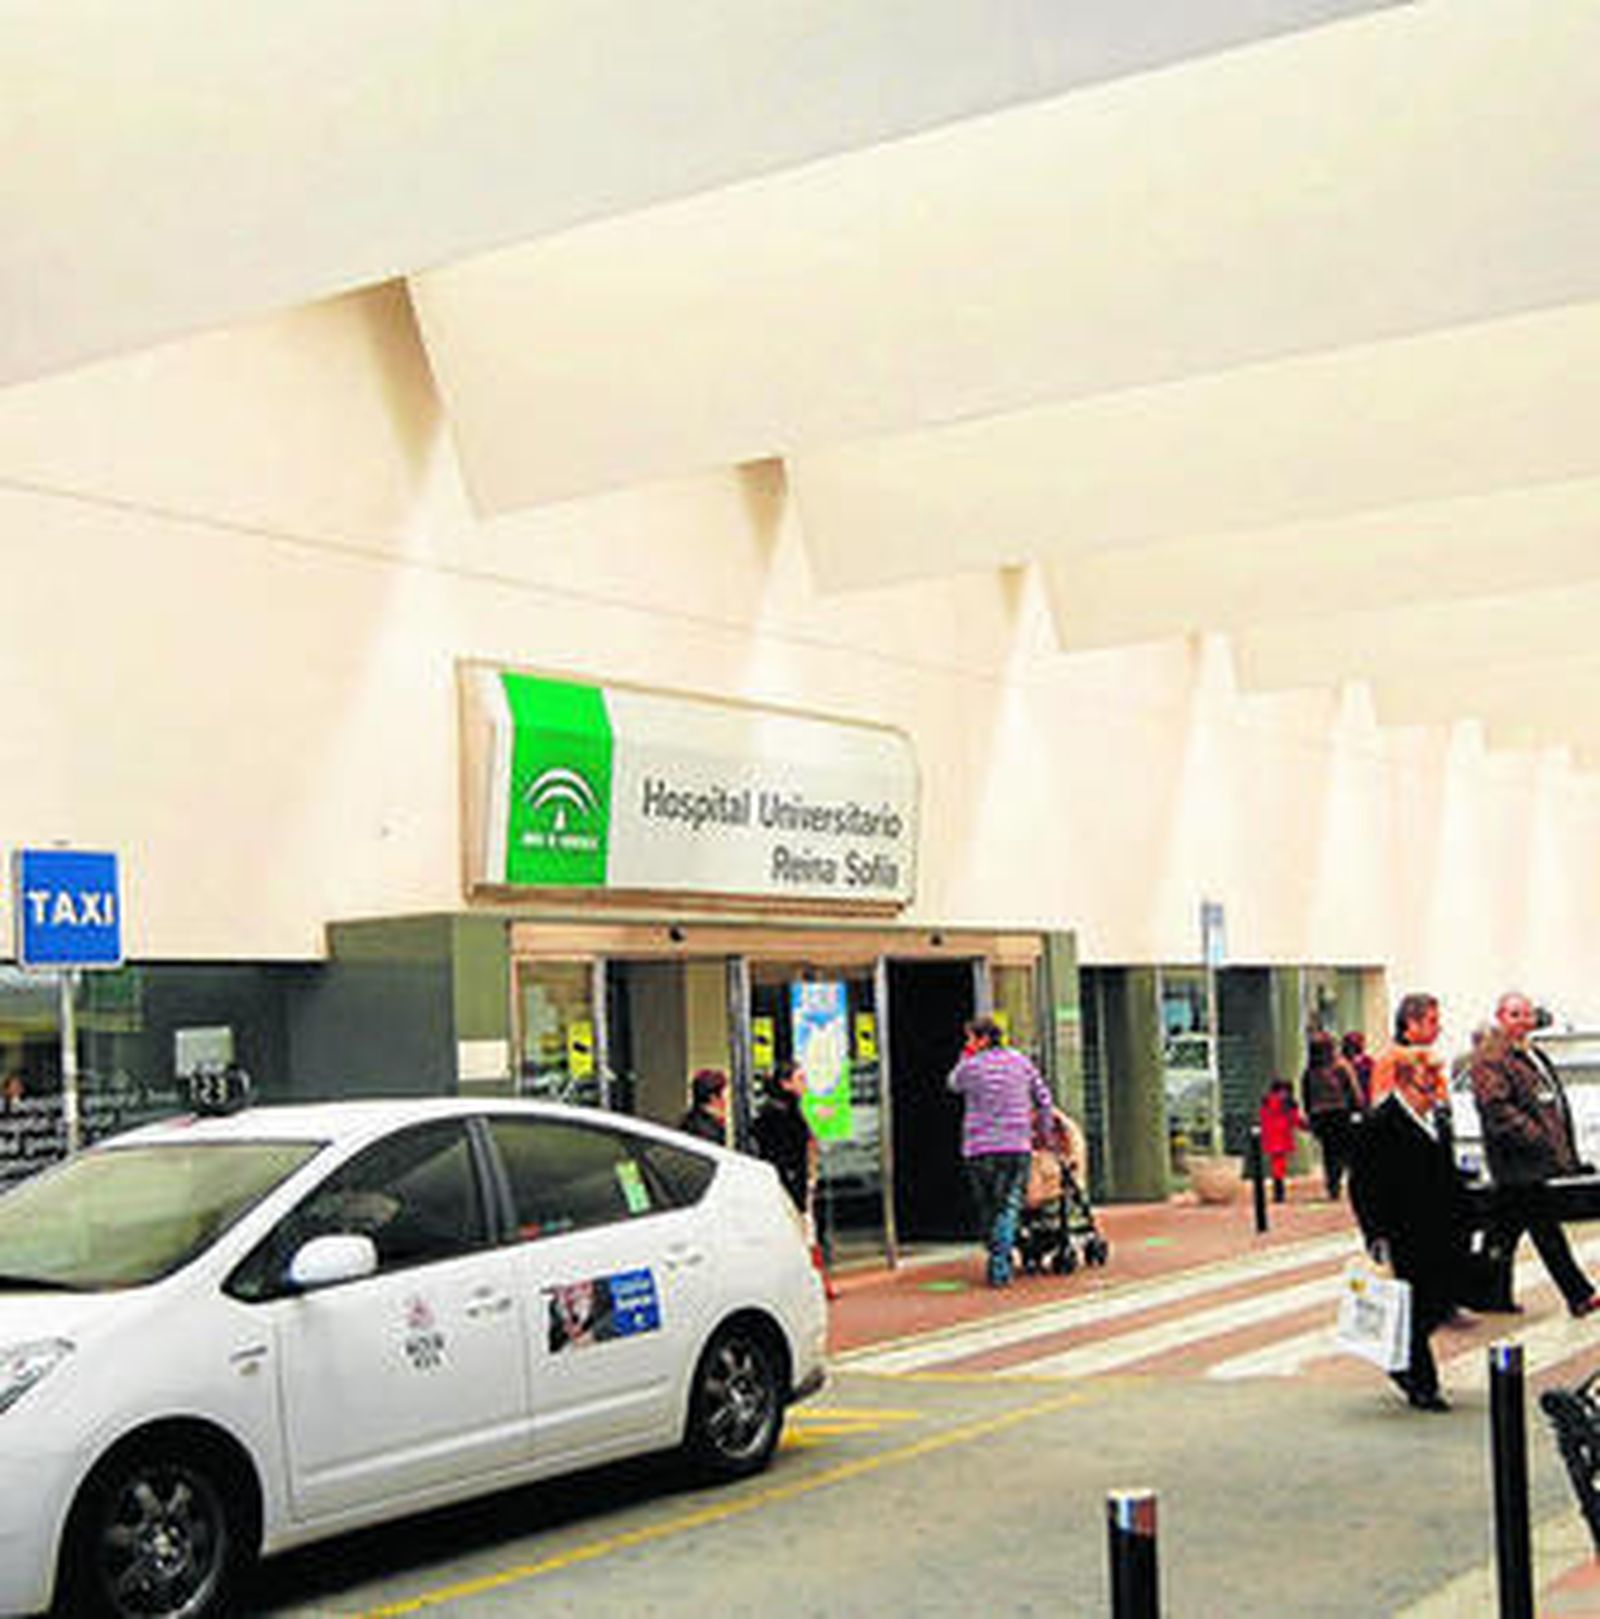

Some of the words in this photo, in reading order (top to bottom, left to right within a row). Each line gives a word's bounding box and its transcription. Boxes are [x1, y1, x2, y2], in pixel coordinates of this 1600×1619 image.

[643, 777, 752, 831] Hospital
[757, 791, 903, 839] Universitario
[770, 845, 837, 884] Reina
[27, 890, 115, 926] TAXI
